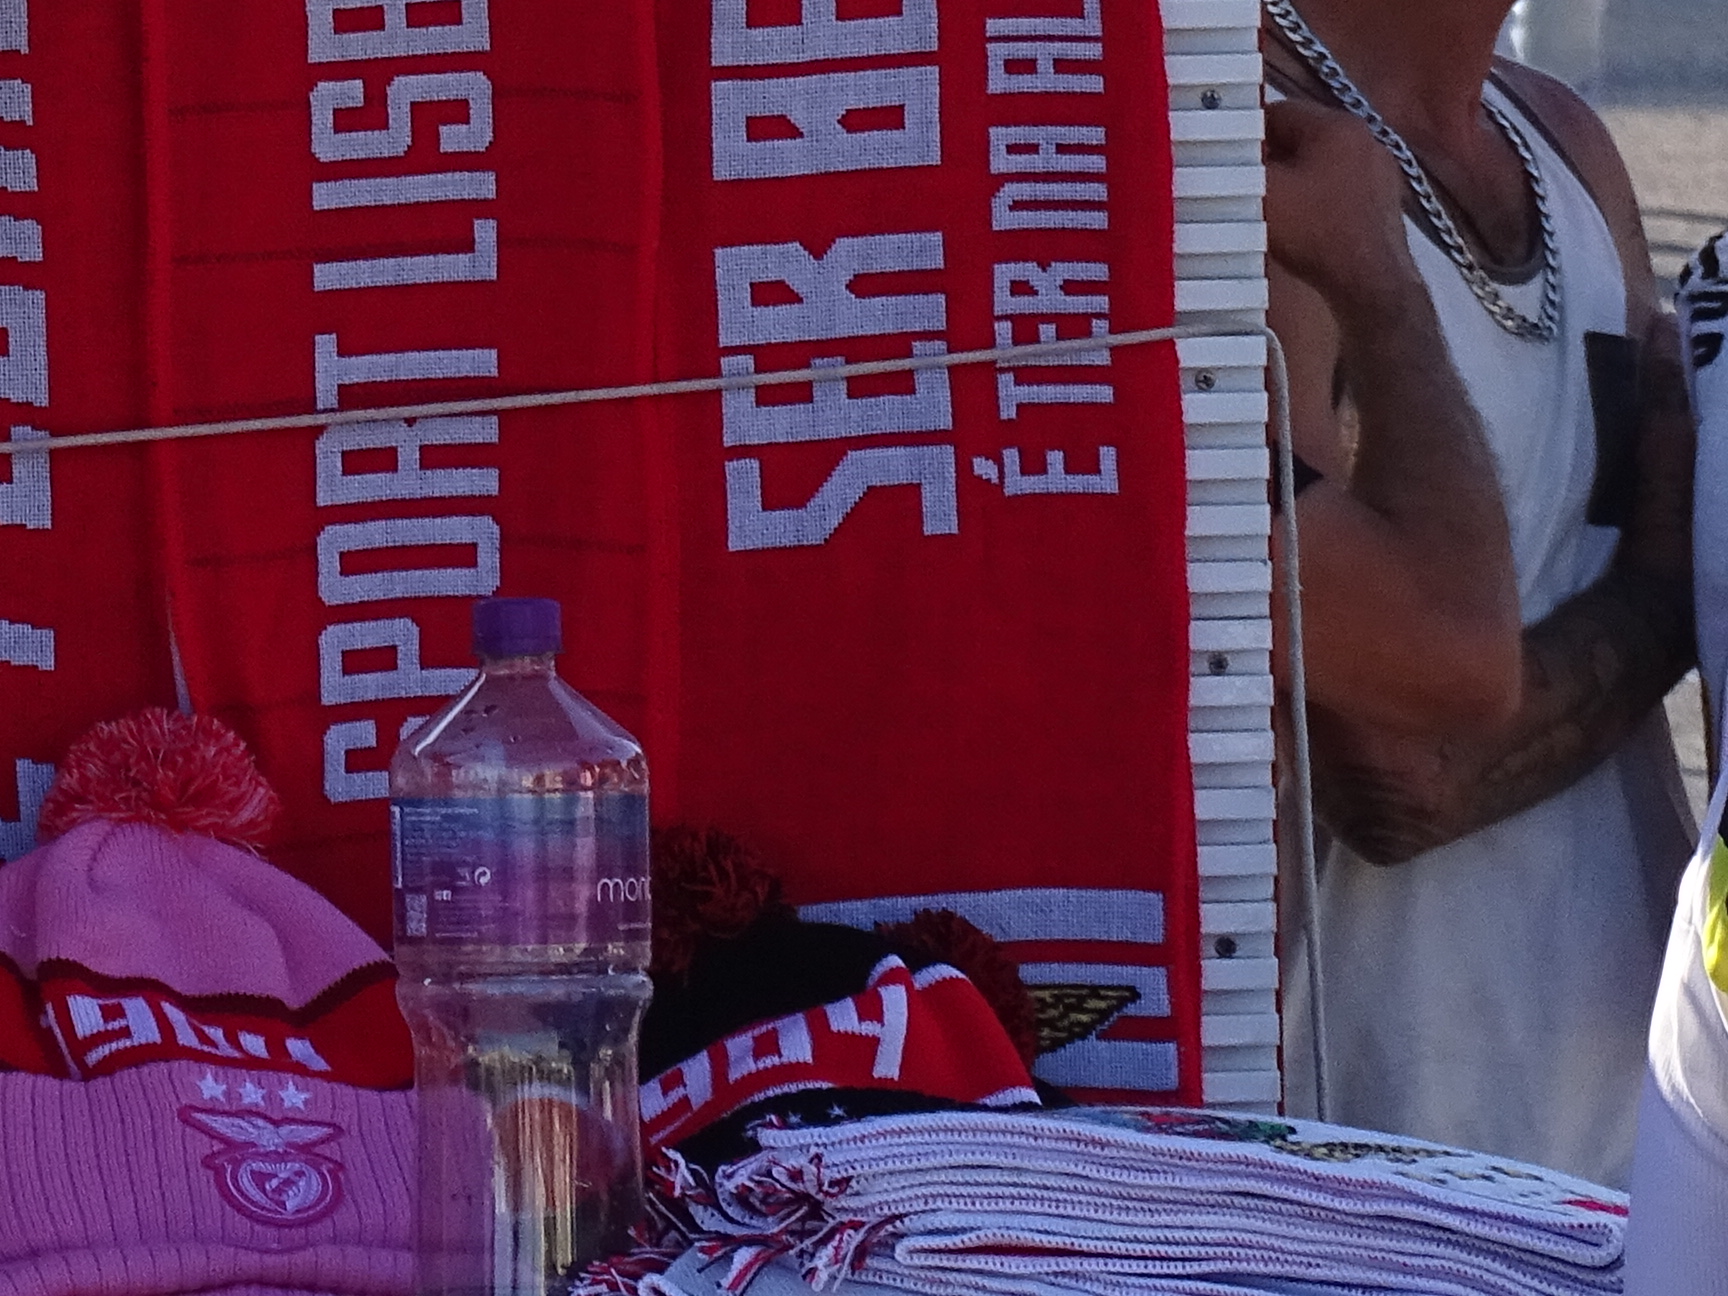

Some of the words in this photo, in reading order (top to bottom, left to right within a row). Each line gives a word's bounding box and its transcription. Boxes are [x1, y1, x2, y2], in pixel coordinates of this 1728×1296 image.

[988, 124, 1109, 231] NA
[713, 230, 959, 553] SER
[993, 260, 1115, 422] TER
[972, 445, 1120, 497] É
